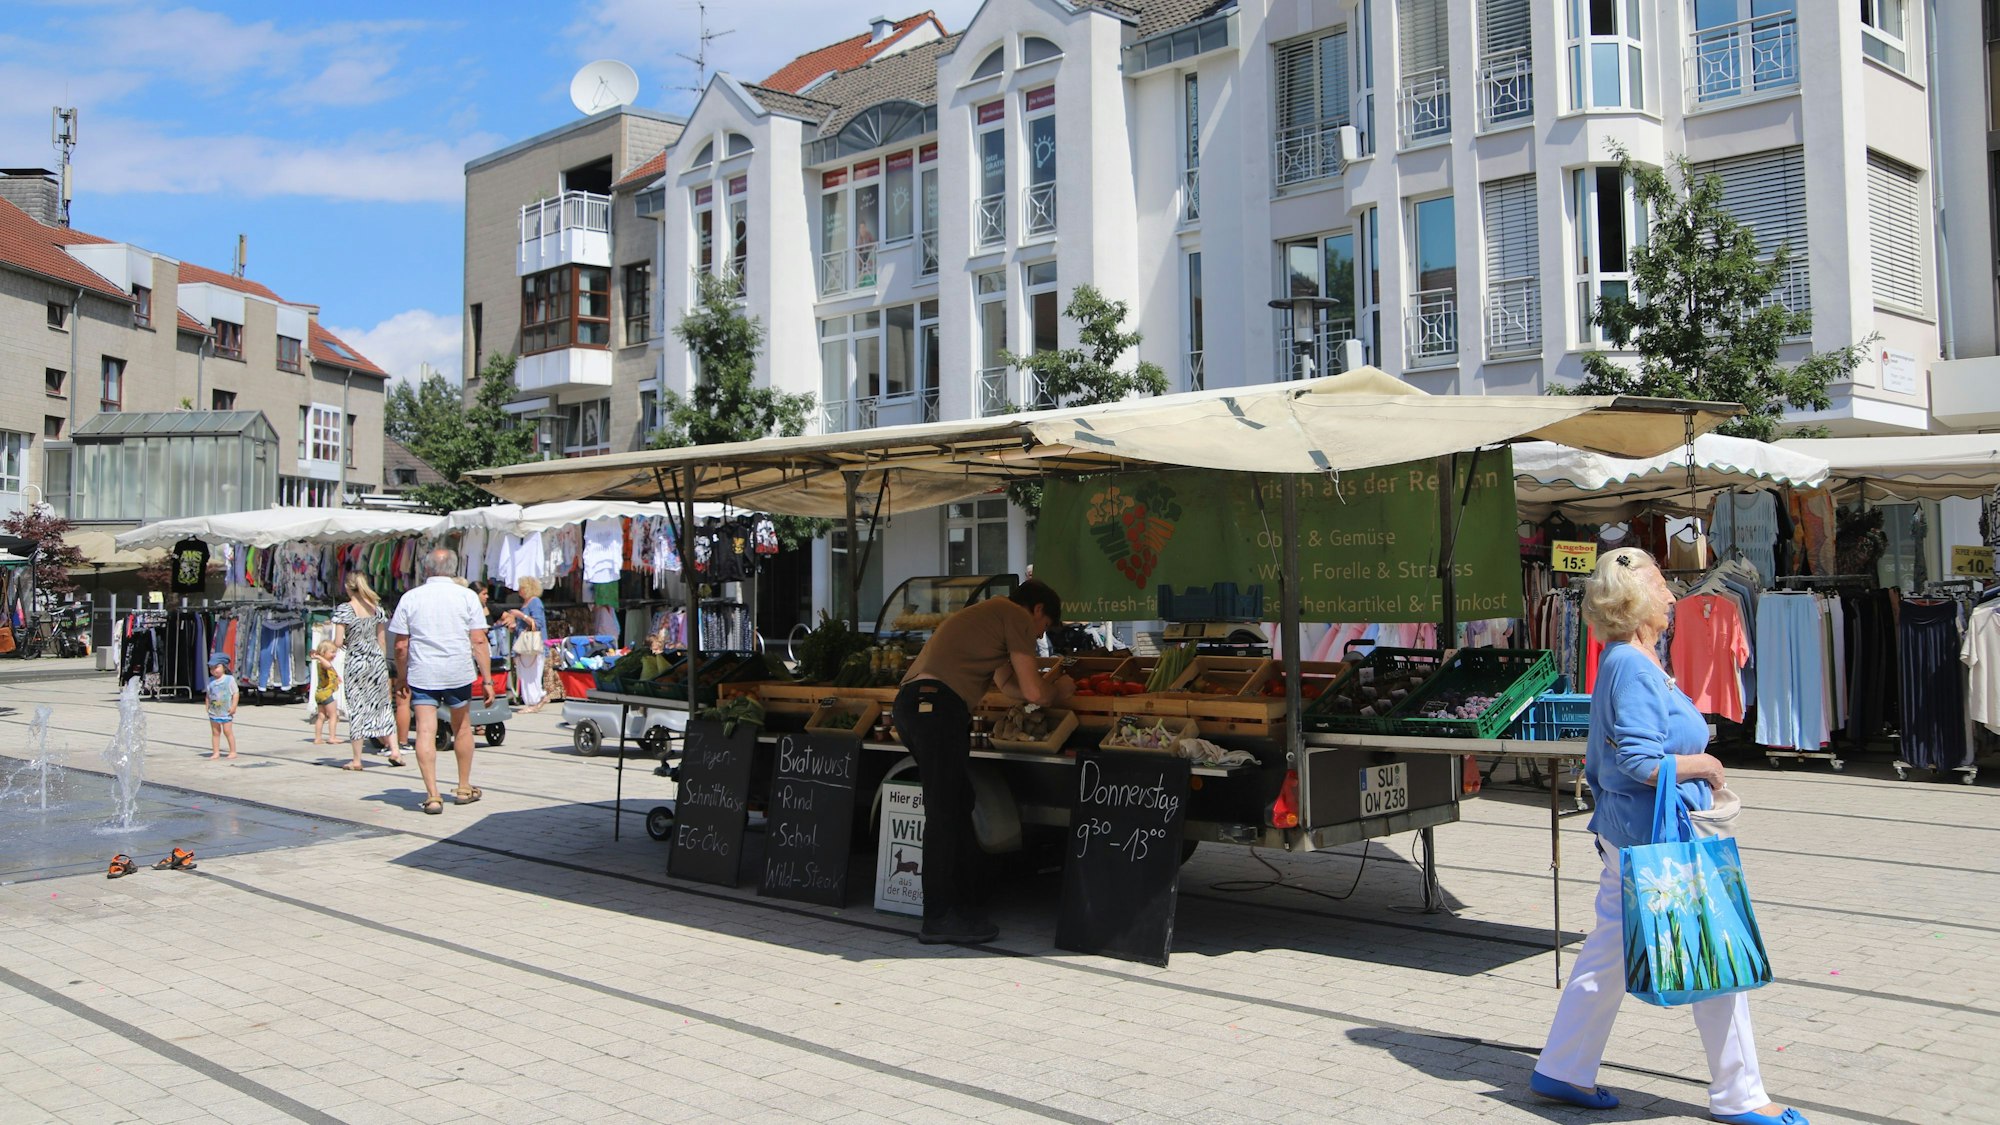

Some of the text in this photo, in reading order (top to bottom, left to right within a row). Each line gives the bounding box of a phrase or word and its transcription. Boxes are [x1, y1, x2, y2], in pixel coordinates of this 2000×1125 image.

[1363, 471, 1400, 495] der
[1308, 530, 1322, 548] &
[1330, 529, 1396, 547] Gemüse
[1556, 543, 1594, 553] Angebot
[1313, 561, 1371, 580] Forelle
[1377, 561, 1391, 579] &
[1398, 561, 1473, 579] Strass
[1263, 593, 1508, 613] Gehenkartikel & Finkost
[779, 736, 852, 778] Bratwurst
[1378, 767, 1394, 788] SU
[889, 791, 911, 805] Hier
[1080, 760, 1179, 824] Donnerstag
[1365, 787, 1406, 813] OW 238
[892, 818, 923, 843] Wil
[887, 884, 900, 896] der
[898, 877, 912, 888] aus
